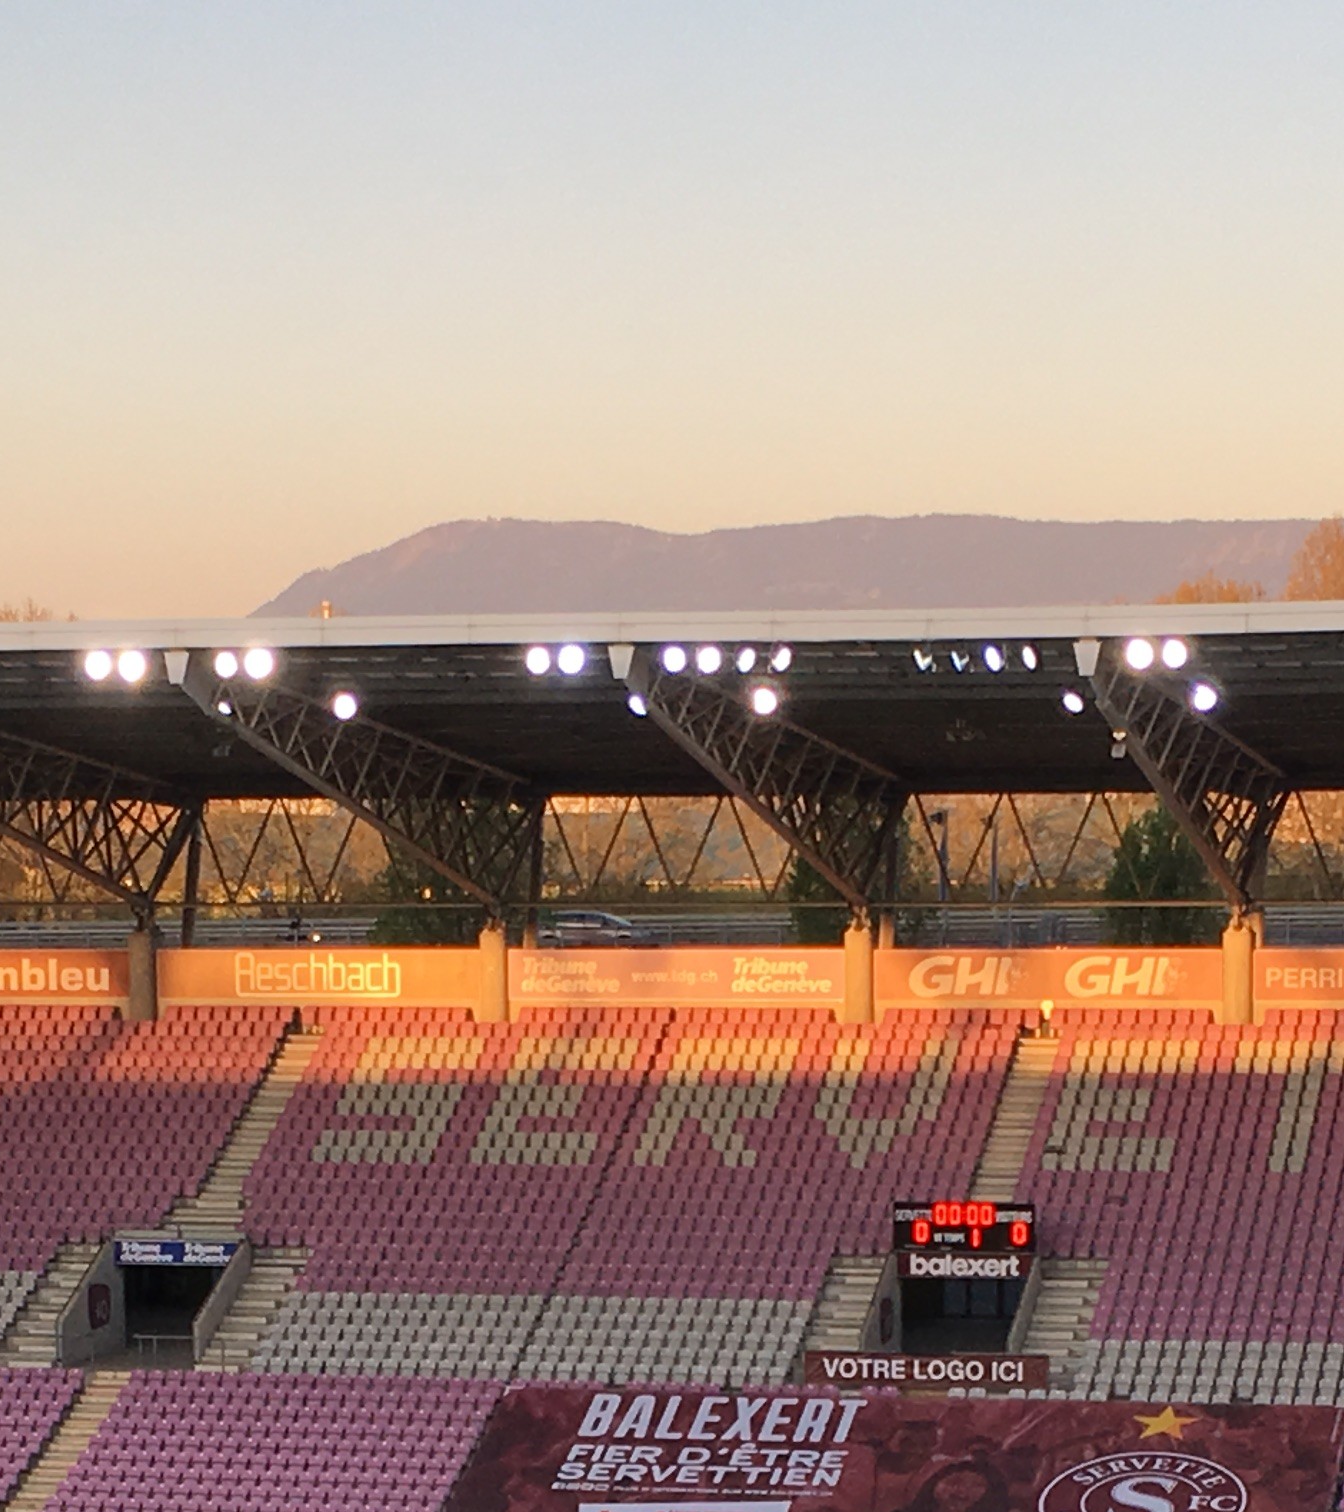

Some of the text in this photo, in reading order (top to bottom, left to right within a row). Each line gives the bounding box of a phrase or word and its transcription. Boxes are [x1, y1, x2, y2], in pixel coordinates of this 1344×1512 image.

[235, 952, 400, 998] Aeschbach
[522, 957, 596, 974] Tribune
[733, 957, 808, 975] Tribune
[908, 956, 1012, 997] GHI
[1064, 956, 1170, 997] GHI
[731, 975, 832, 993] deGenève
[915, 1221, 929, 1243] 0
[1012, 1222, 1028, 1245] 0
[910, 1254, 1020, 1277] balexert
[823, 1358, 1024, 1382] VOTRE LOGO ICI
[577, 1393, 867, 1443] BALEXERT
[566, 1443, 848, 1469] FIER D'ÊTRE
[557, 1463, 843, 1488] SERVETTIEN
[1072, 1457, 1226, 1489] SERVETTE
[1188, 1495, 1239, 1512] FC
